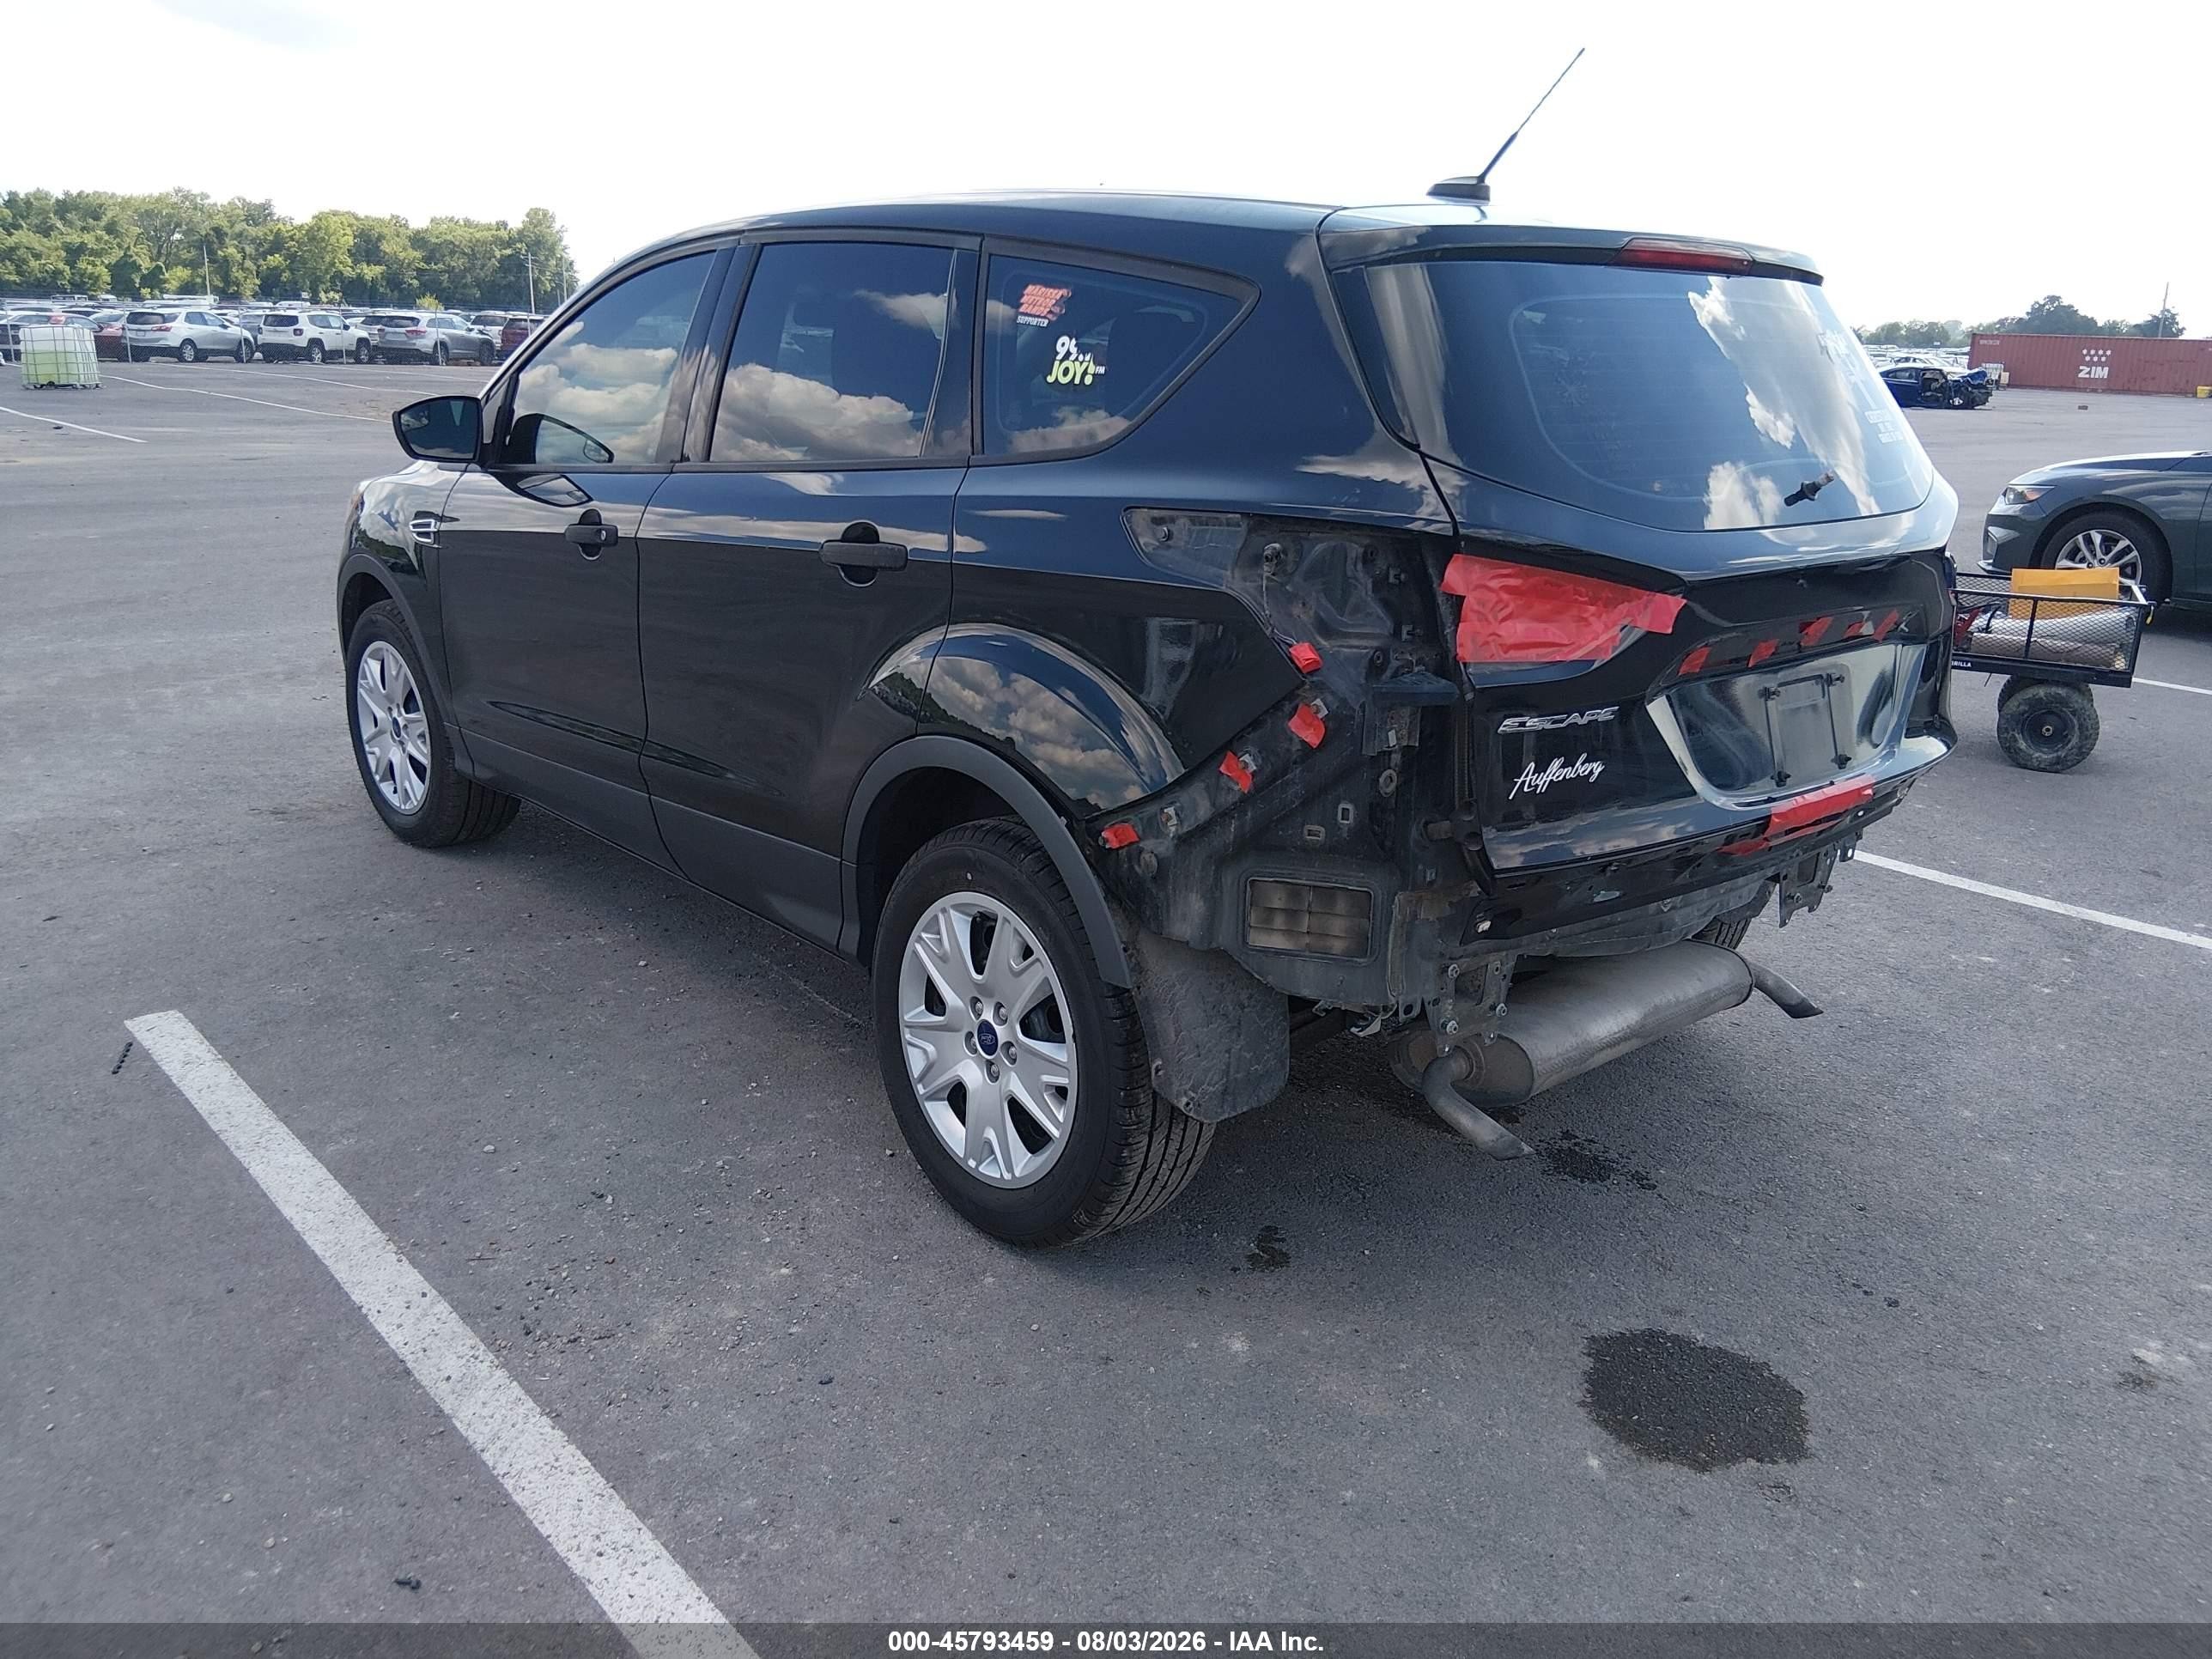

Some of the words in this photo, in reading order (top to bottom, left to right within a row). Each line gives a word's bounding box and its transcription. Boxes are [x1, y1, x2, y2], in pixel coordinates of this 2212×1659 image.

[1017, 315, 1049, 327] SUPPORTER
[1046, 353, 1096, 386] JOY!
[1095, 366, 1106, 374] FM
[2078, 366, 2109, 379] ZIM
[1498, 706, 1620, 733] ESCAPE
[1508, 752, 1605, 799] Auffenberg
